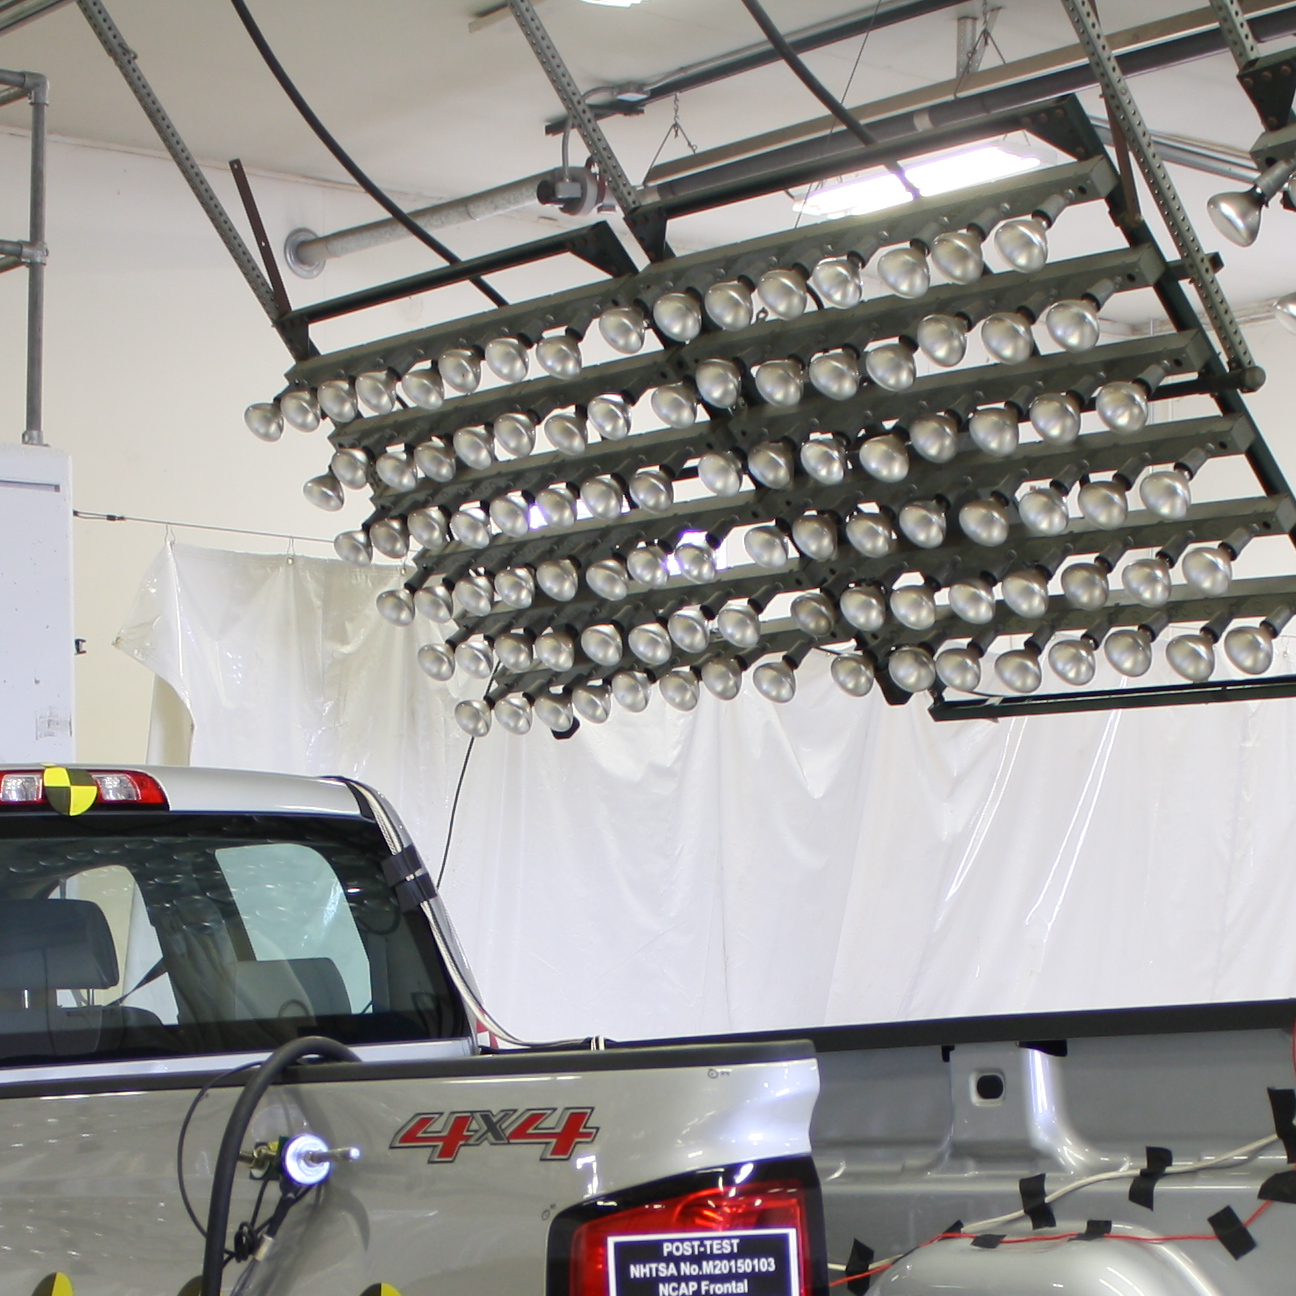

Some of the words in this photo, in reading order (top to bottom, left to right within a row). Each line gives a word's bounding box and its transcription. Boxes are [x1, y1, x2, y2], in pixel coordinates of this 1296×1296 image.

[662, 1239, 740, 1257] POST-TEST
[629, 1263, 678, 1279] NHTSA
[658, 1281, 698, 1296] NCAP
[701, 1279, 748, 1295] Frontal
